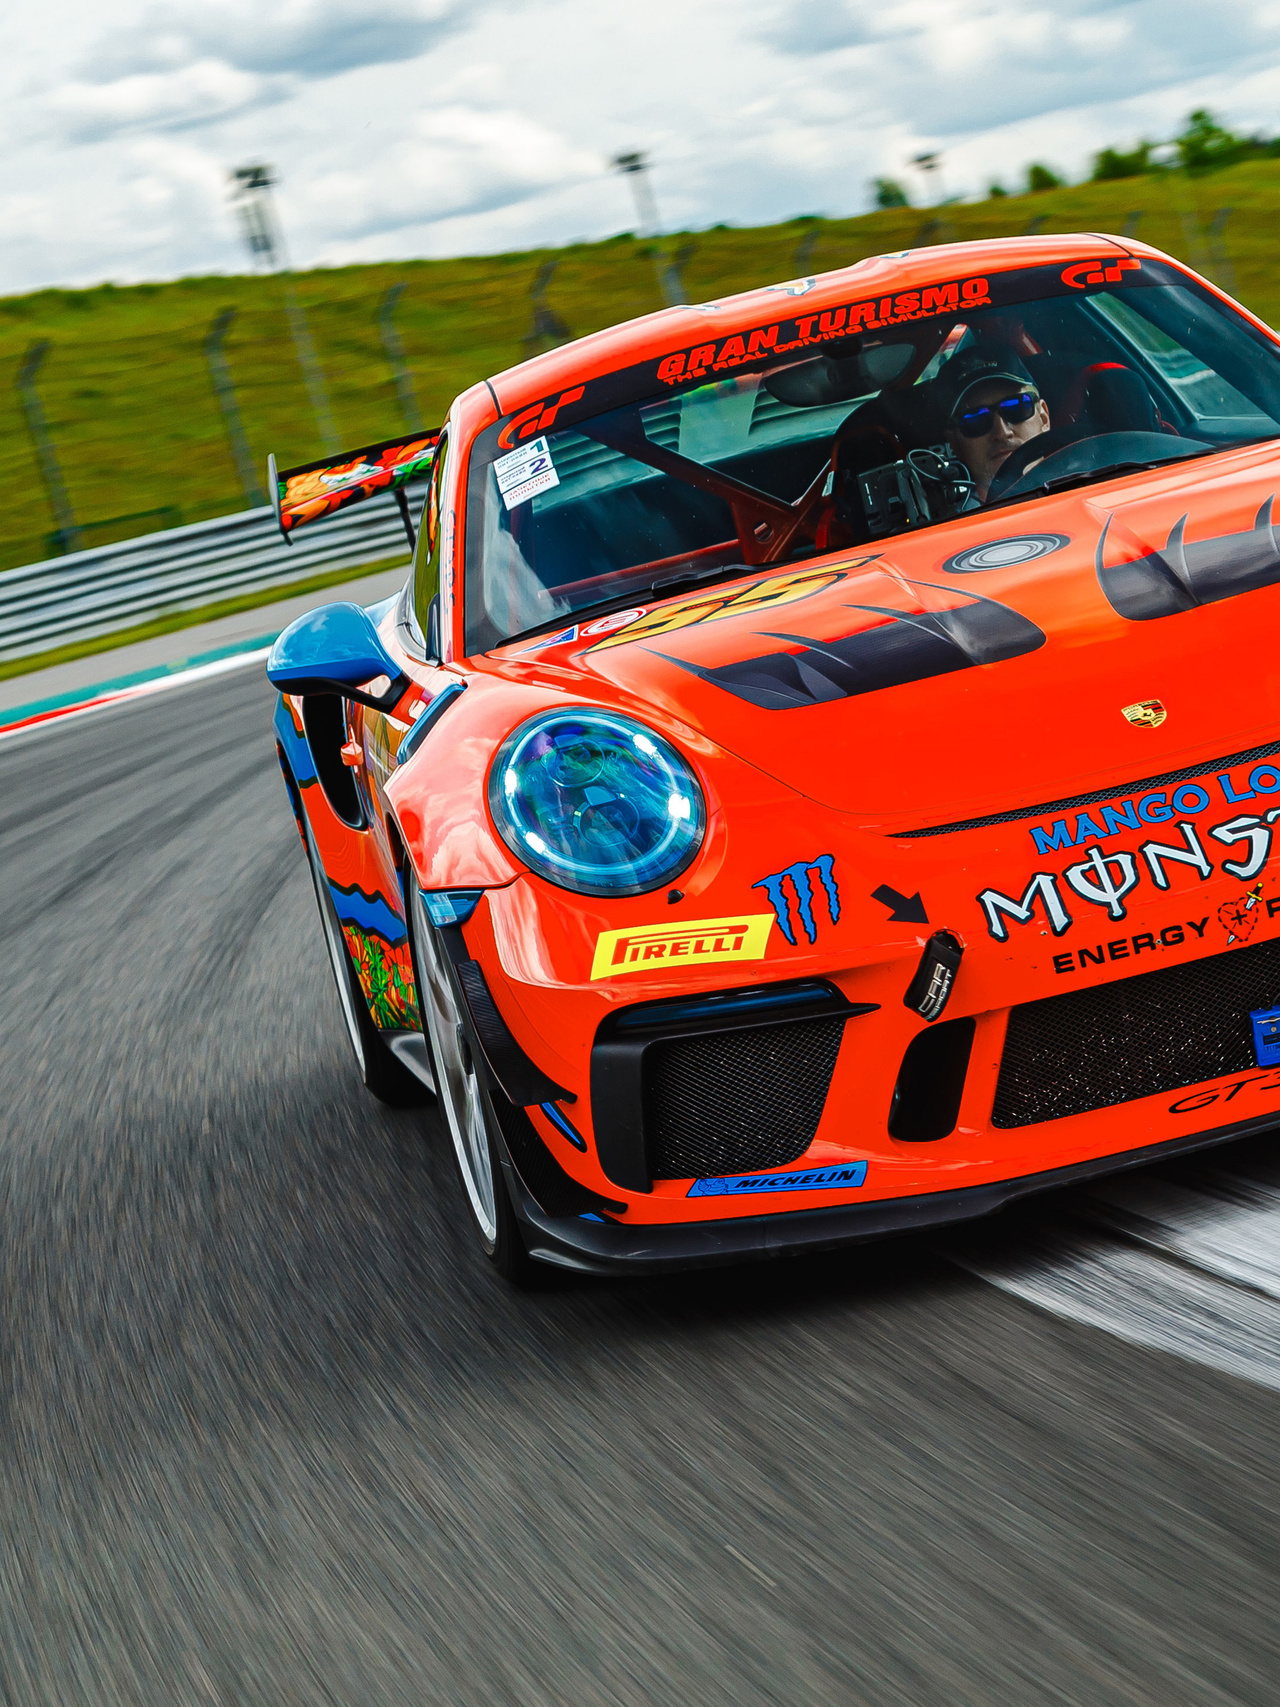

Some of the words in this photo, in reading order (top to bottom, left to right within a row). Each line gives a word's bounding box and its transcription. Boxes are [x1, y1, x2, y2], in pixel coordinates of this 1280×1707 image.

[1061, 258, 1141, 288] GT
[656, 325, 779, 380] GRAN
[795, 278, 989, 338] TURISMO
[663, 368, 707, 386] THE
[712, 351, 768, 372] REAL
[773, 324, 863, 354] DRIVING
[866, 296, 992, 328] SIMULATOR
[498, 386, 586, 449] GT
[530, 439, 544, 453] 1
[529, 457, 549, 475] 2
[572, 553, 884, 657] 55
[1029, 784, 1210, 856] MANGO
[610, 924, 750, 966] PIRELLI
[1053, 915, 1211, 974] ENERGY
[734, 1168, 859, 1189] MICHELIN
